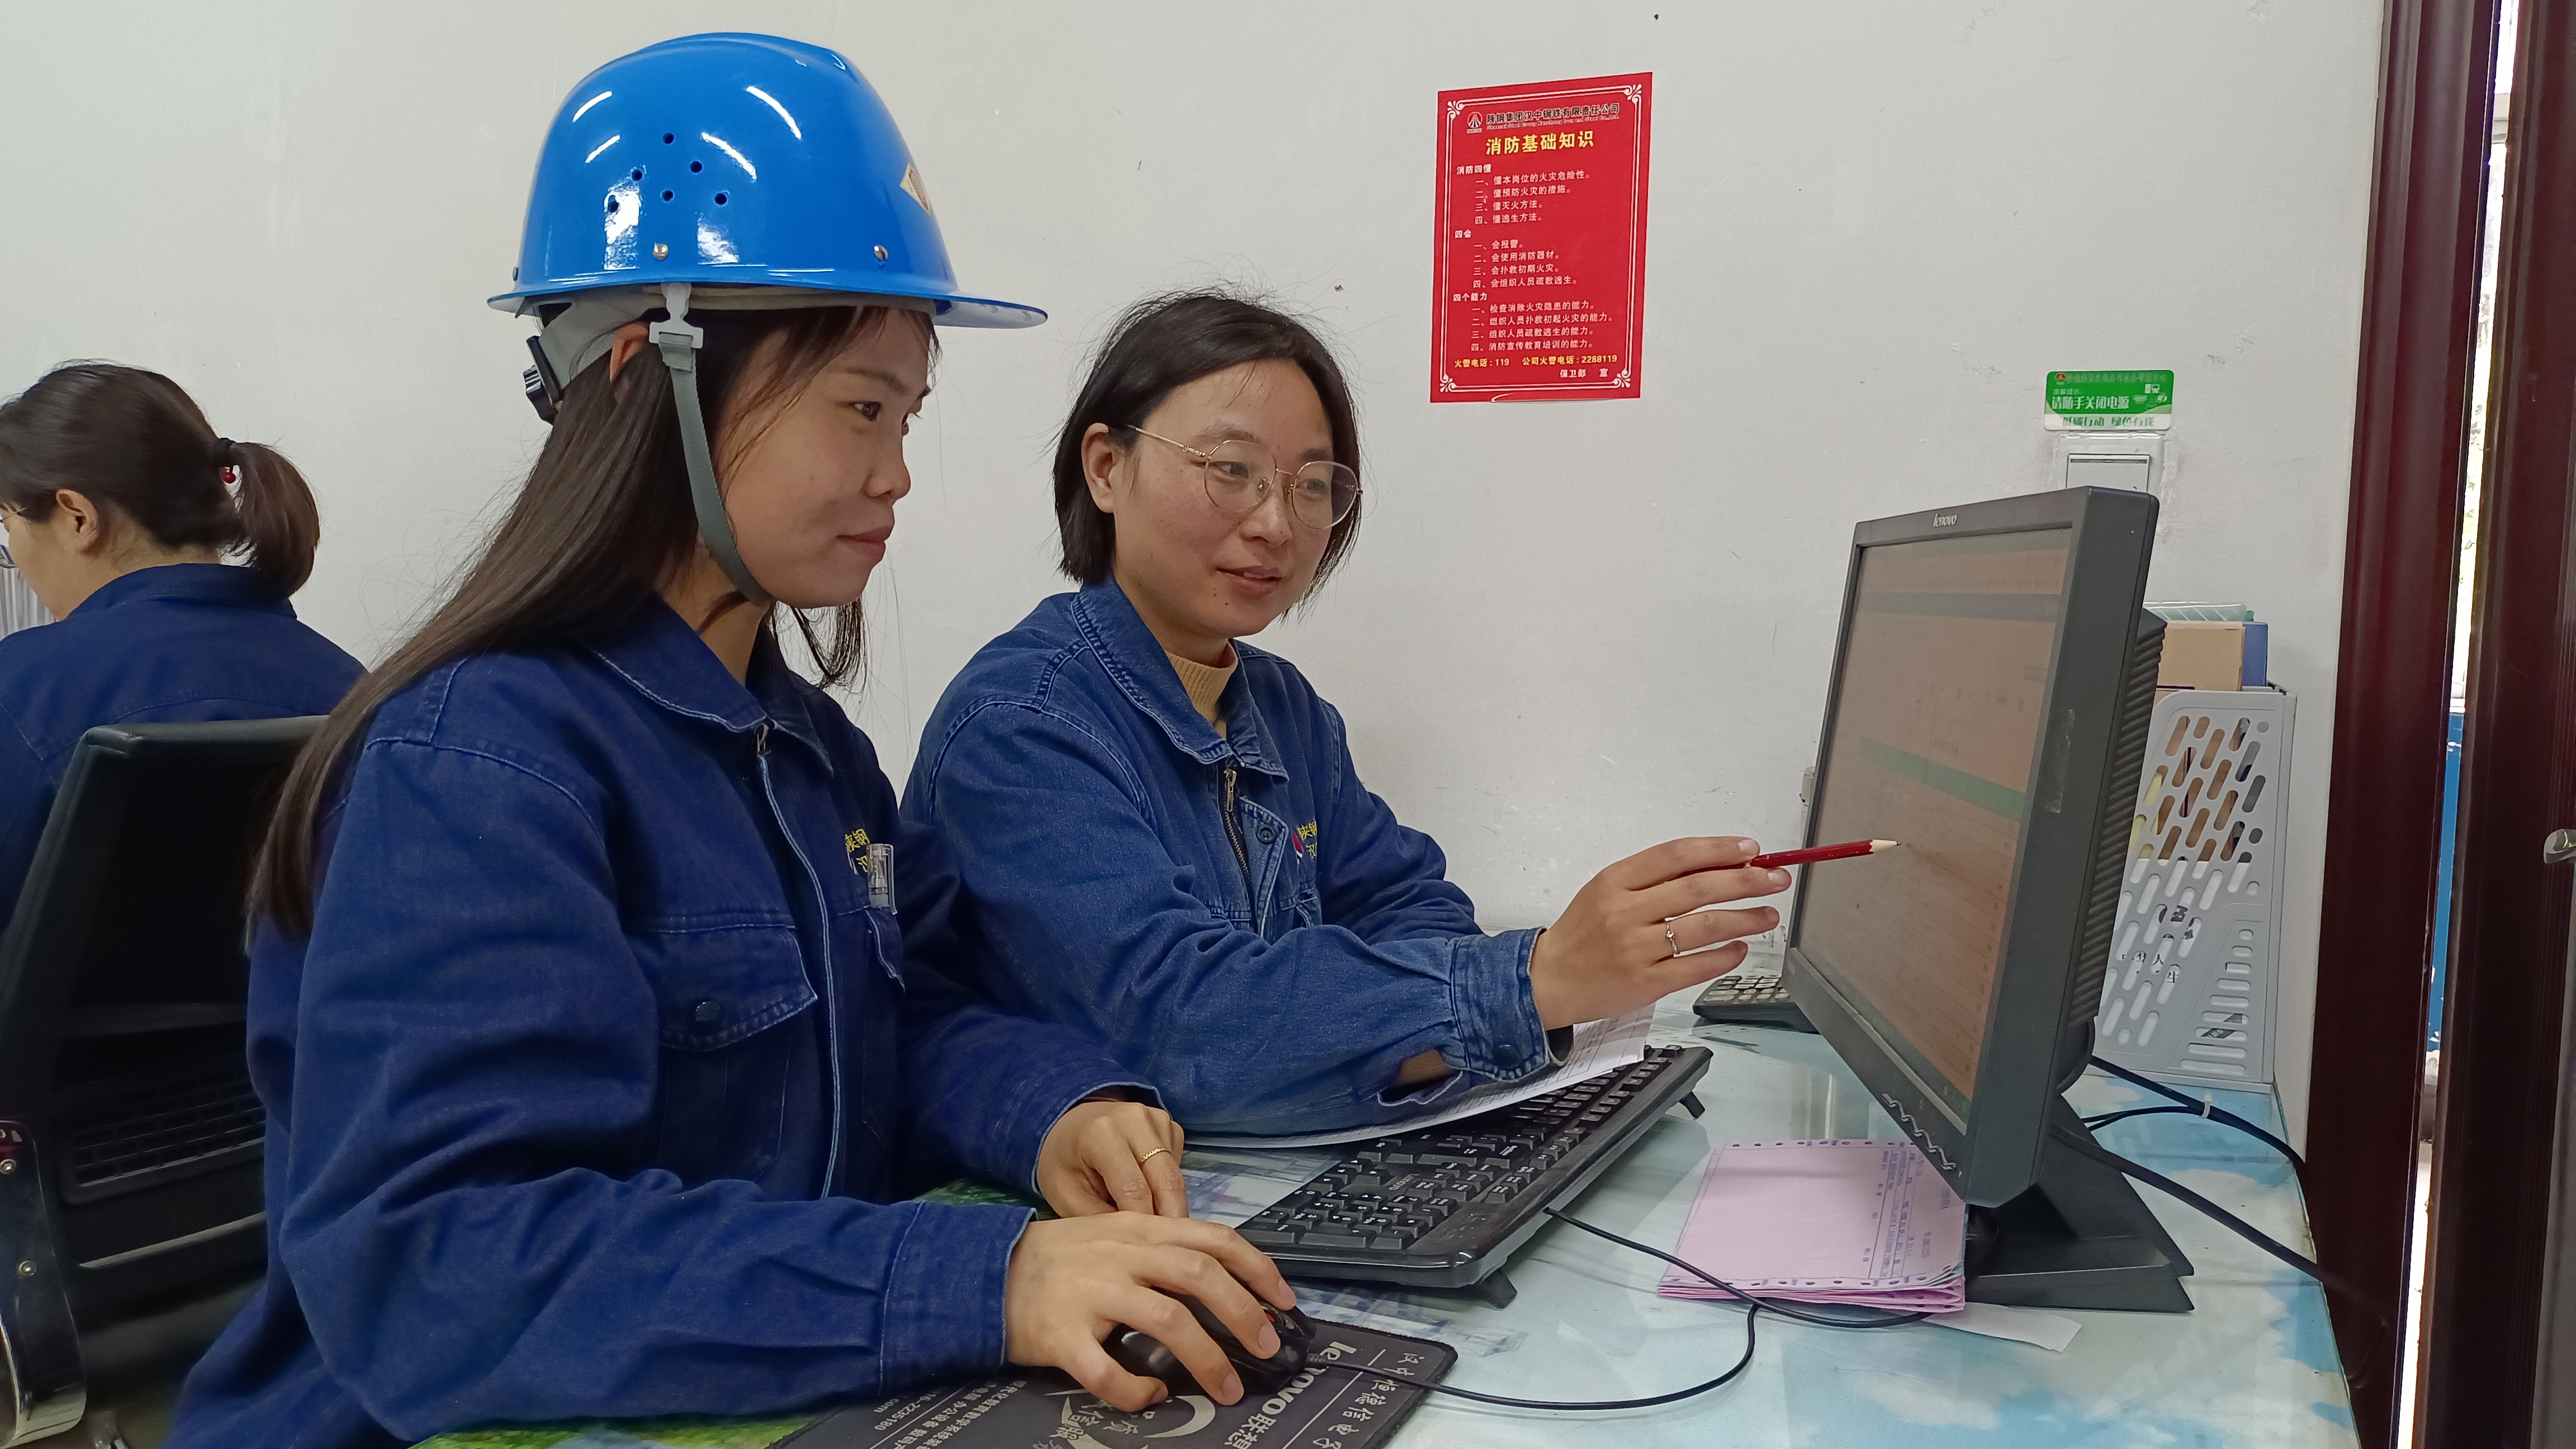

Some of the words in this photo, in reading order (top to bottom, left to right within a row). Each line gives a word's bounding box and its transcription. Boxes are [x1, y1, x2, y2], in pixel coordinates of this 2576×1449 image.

[1485, 130, 1594, 155] 消防基础知识
[1455, 230, 1472, 239] 四会
[1453, 292, 1488, 302] 四个能力
[2052, 395, 2129, 410] 请随手关闭电源
[1932, 513, 1957, 527] lenovo
